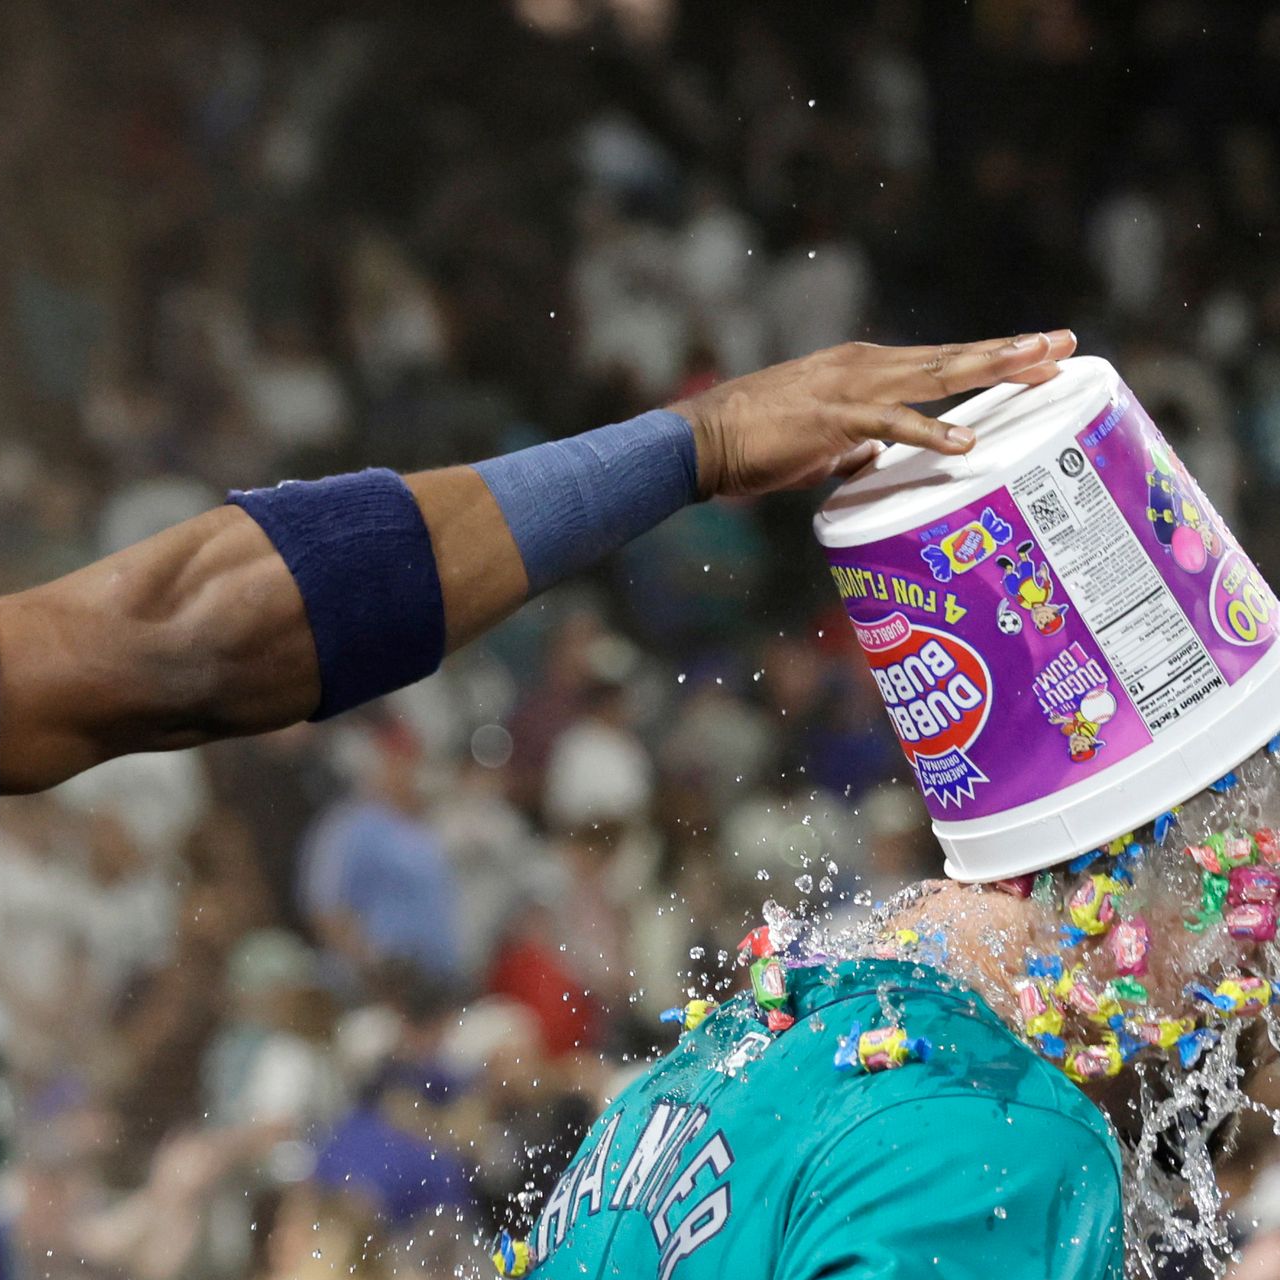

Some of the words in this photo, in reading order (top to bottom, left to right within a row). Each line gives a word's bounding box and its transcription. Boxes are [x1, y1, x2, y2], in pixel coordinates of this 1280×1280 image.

[891, 577, 935, 612] FUN
[940, 593, 968, 626] 4
[871, 619, 904, 644] BUBBLE
[1035, 649, 1078, 690] GUM
[1167, 640, 1199, 666] Calories
[870, 640, 955, 702] BUBB
[1038, 658, 1108, 713] DUGOUT
[1128, 680, 1145, 697] 15
[1179, 675, 1222, 711] Nutrition
[885, 672, 982, 742] DUBBL
[1149, 707, 1180, 732] Facts
[919, 754, 959, 770] ORIGINAL
[922, 762, 967, 784] AMERICA'S
